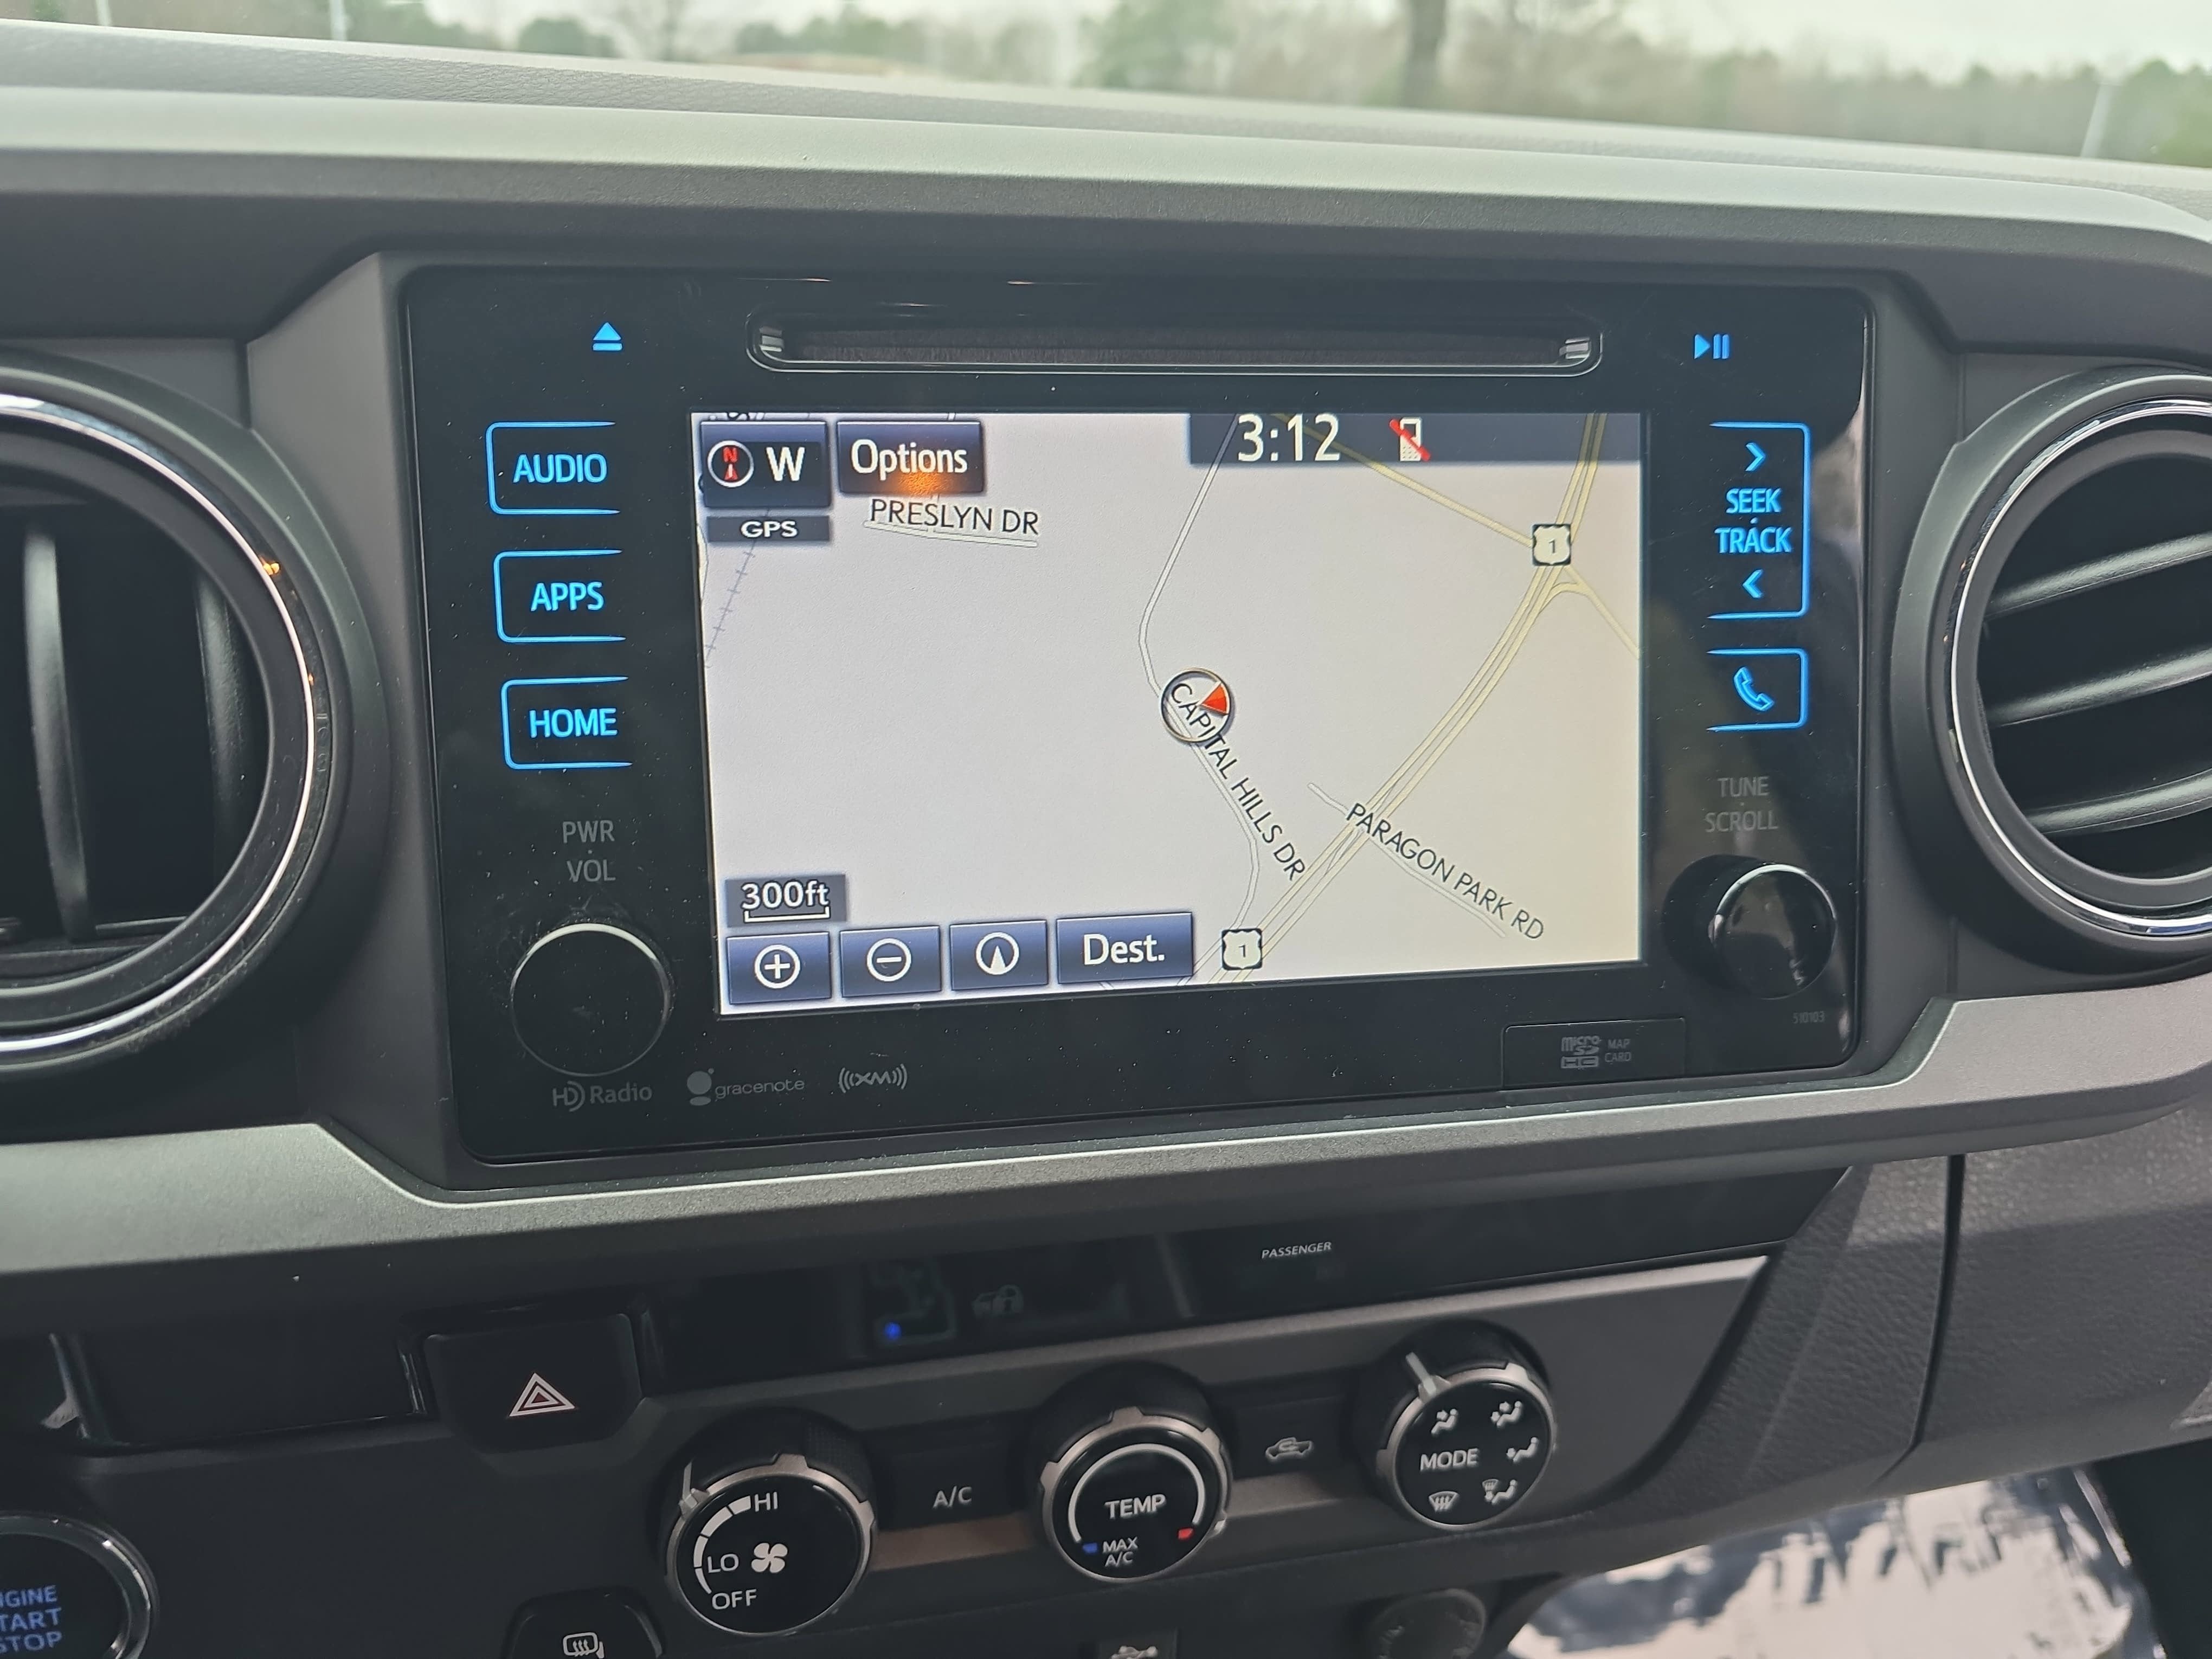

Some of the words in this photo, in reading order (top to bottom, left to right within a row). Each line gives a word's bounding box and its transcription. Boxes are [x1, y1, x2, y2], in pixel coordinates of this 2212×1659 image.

[1237, 413, 1341, 462] 3:12
[723, 447, 738, 462] N
[766, 446, 806, 482] W
[851, 439, 968, 481] Options
[513, 453, 608, 484] AUDIO
[1725, 488, 1782, 515] SEEK
[741, 519, 799, 538] GPS
[870, 498, 993, 531] PRESLYN
[1002, 509, 1039, 536] DR
[1548, 539, 1557, 555] 1
[1714, 526, 1792, 554] TRACK
[530, 581, 605, 612] APPS
[528, 708, 618, 738] HOME
[1170, 682, 1238, 781] CAPITAL
[1231, 776, 1283, 844] HILLS
[1272, 842, 1306, 881] DR
[1717, 776, 1769, 798] TUNE
[562, 819, 615, 844] PWR
[1704, 811, 1779, 834] SCROLL
[565, 858, 616, 883] VOL
[1346, 802, 1456, 883] PARAGON
[1453, 872, 1513, 921] PARK
[1510, 909, 1545, 940] RD
[741, 879, 830, 910] 300ft
[1083, 933, 1166, 966] Dest.
[1238, 944, 1246, 959] 1
[1607, 1038, 1632, 1050] MAP
[1604, 1051, 1632, 1063] CARD
[552, 1083, 584, 1109] HD
[589, 1081, 653, 1104] Radio
[715, 1078, 806, 1099] gracenote
[1261, 1241, 1333, 1259] PASSENGER
[1419, 1447, 1480, 1471] MODE
[754, 1491, 779, 1513] HI
[932, 1486, 973, 1510] A/C
[1104, 1493, 1167, 1520] TEMP
[1102, 1536, 1139, 1554] MAX
[706, 1552, 740, 1573] LO
[1104, 1551, 1134, 1568] A/C
[0, 1584, 57, 1609] GINE
[711, 1588, 757, 1610] OFF
[0, 1607, 62, 1632] TART
